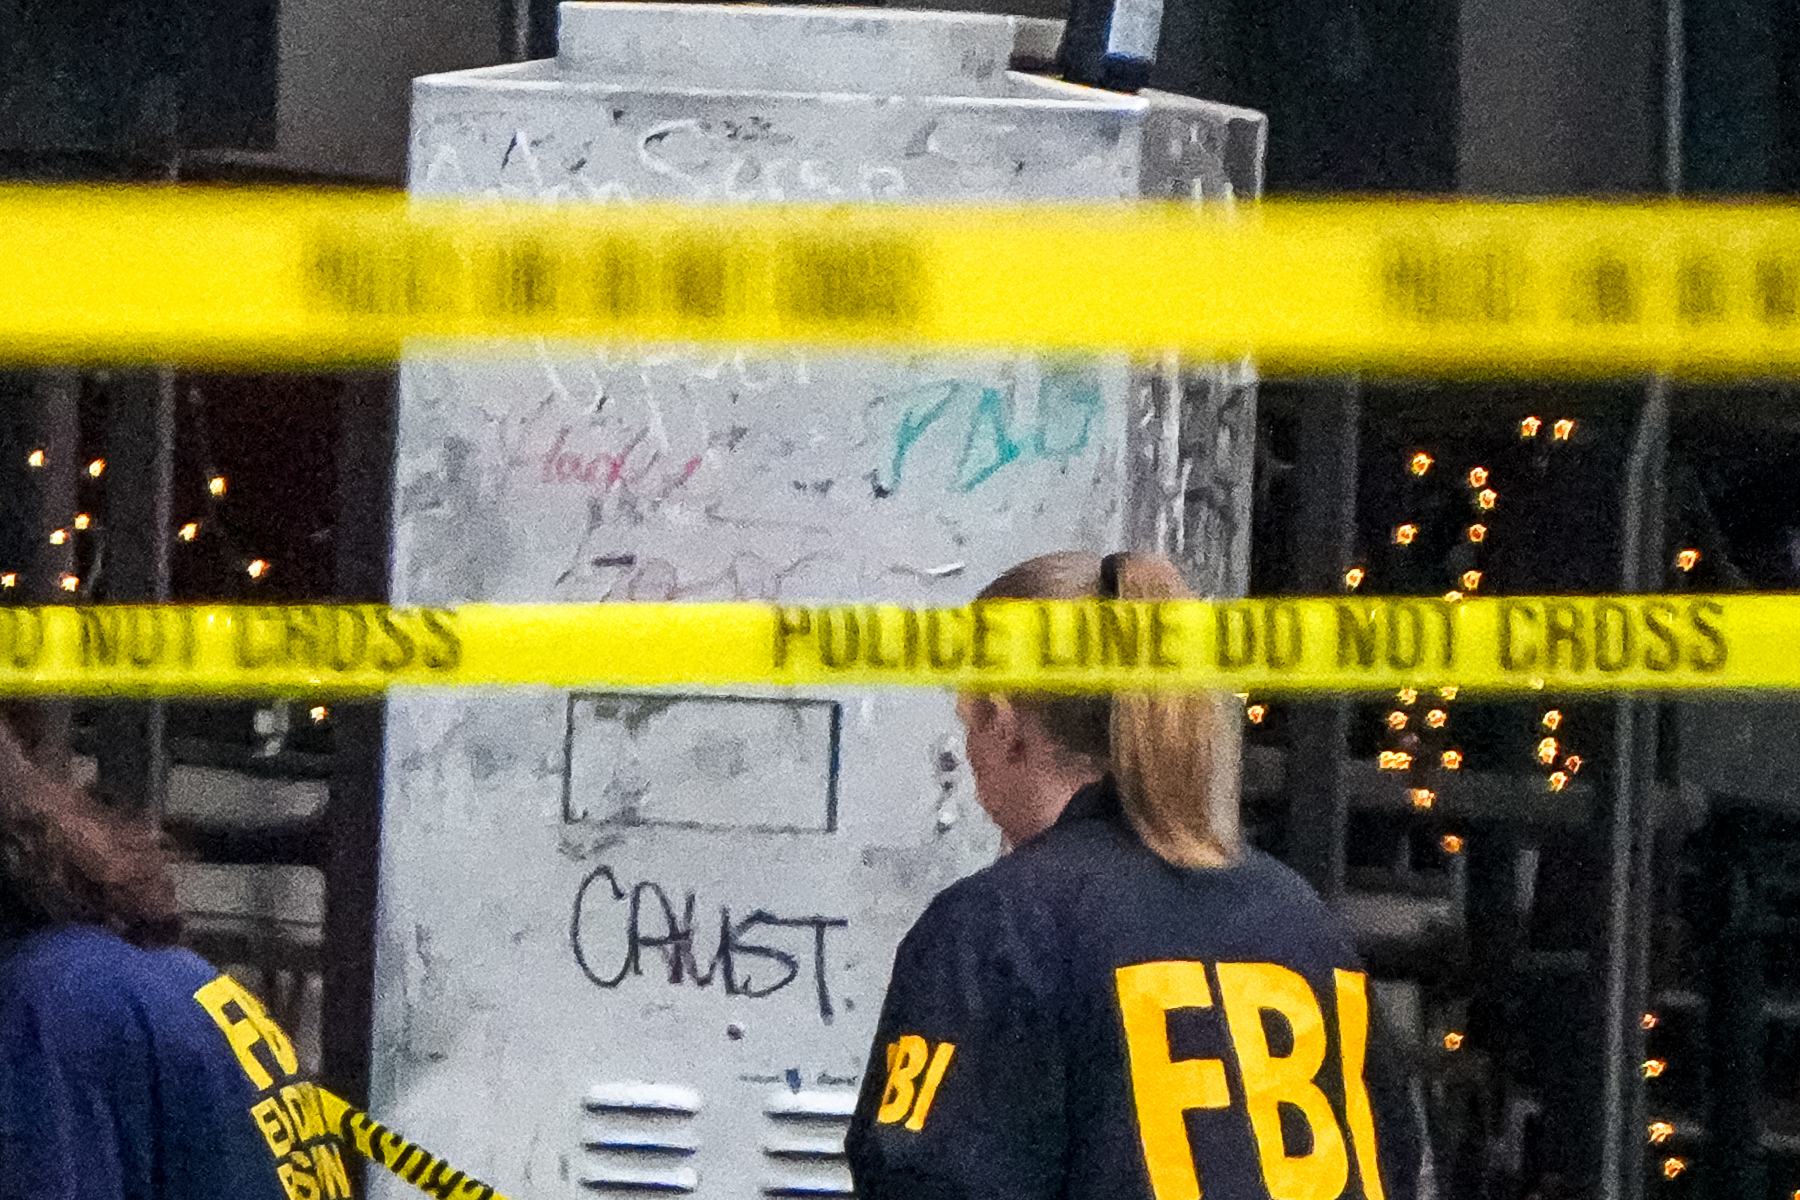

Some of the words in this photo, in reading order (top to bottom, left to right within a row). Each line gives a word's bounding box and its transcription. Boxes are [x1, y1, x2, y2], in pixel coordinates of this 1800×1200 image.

[78, 606, 201, 667] NOT
[233, 606, 462, 671] CROSS
[772, 602, 999, 669] POLICE
[1037, 602, 1184, 669] LINE
[1213, 601, 1302, 670] DO
[1335, 601, 1459, 670] NOT
[1501, 600, 1729, 672] CROSS
[876, 1034, 956, 1132] BI
